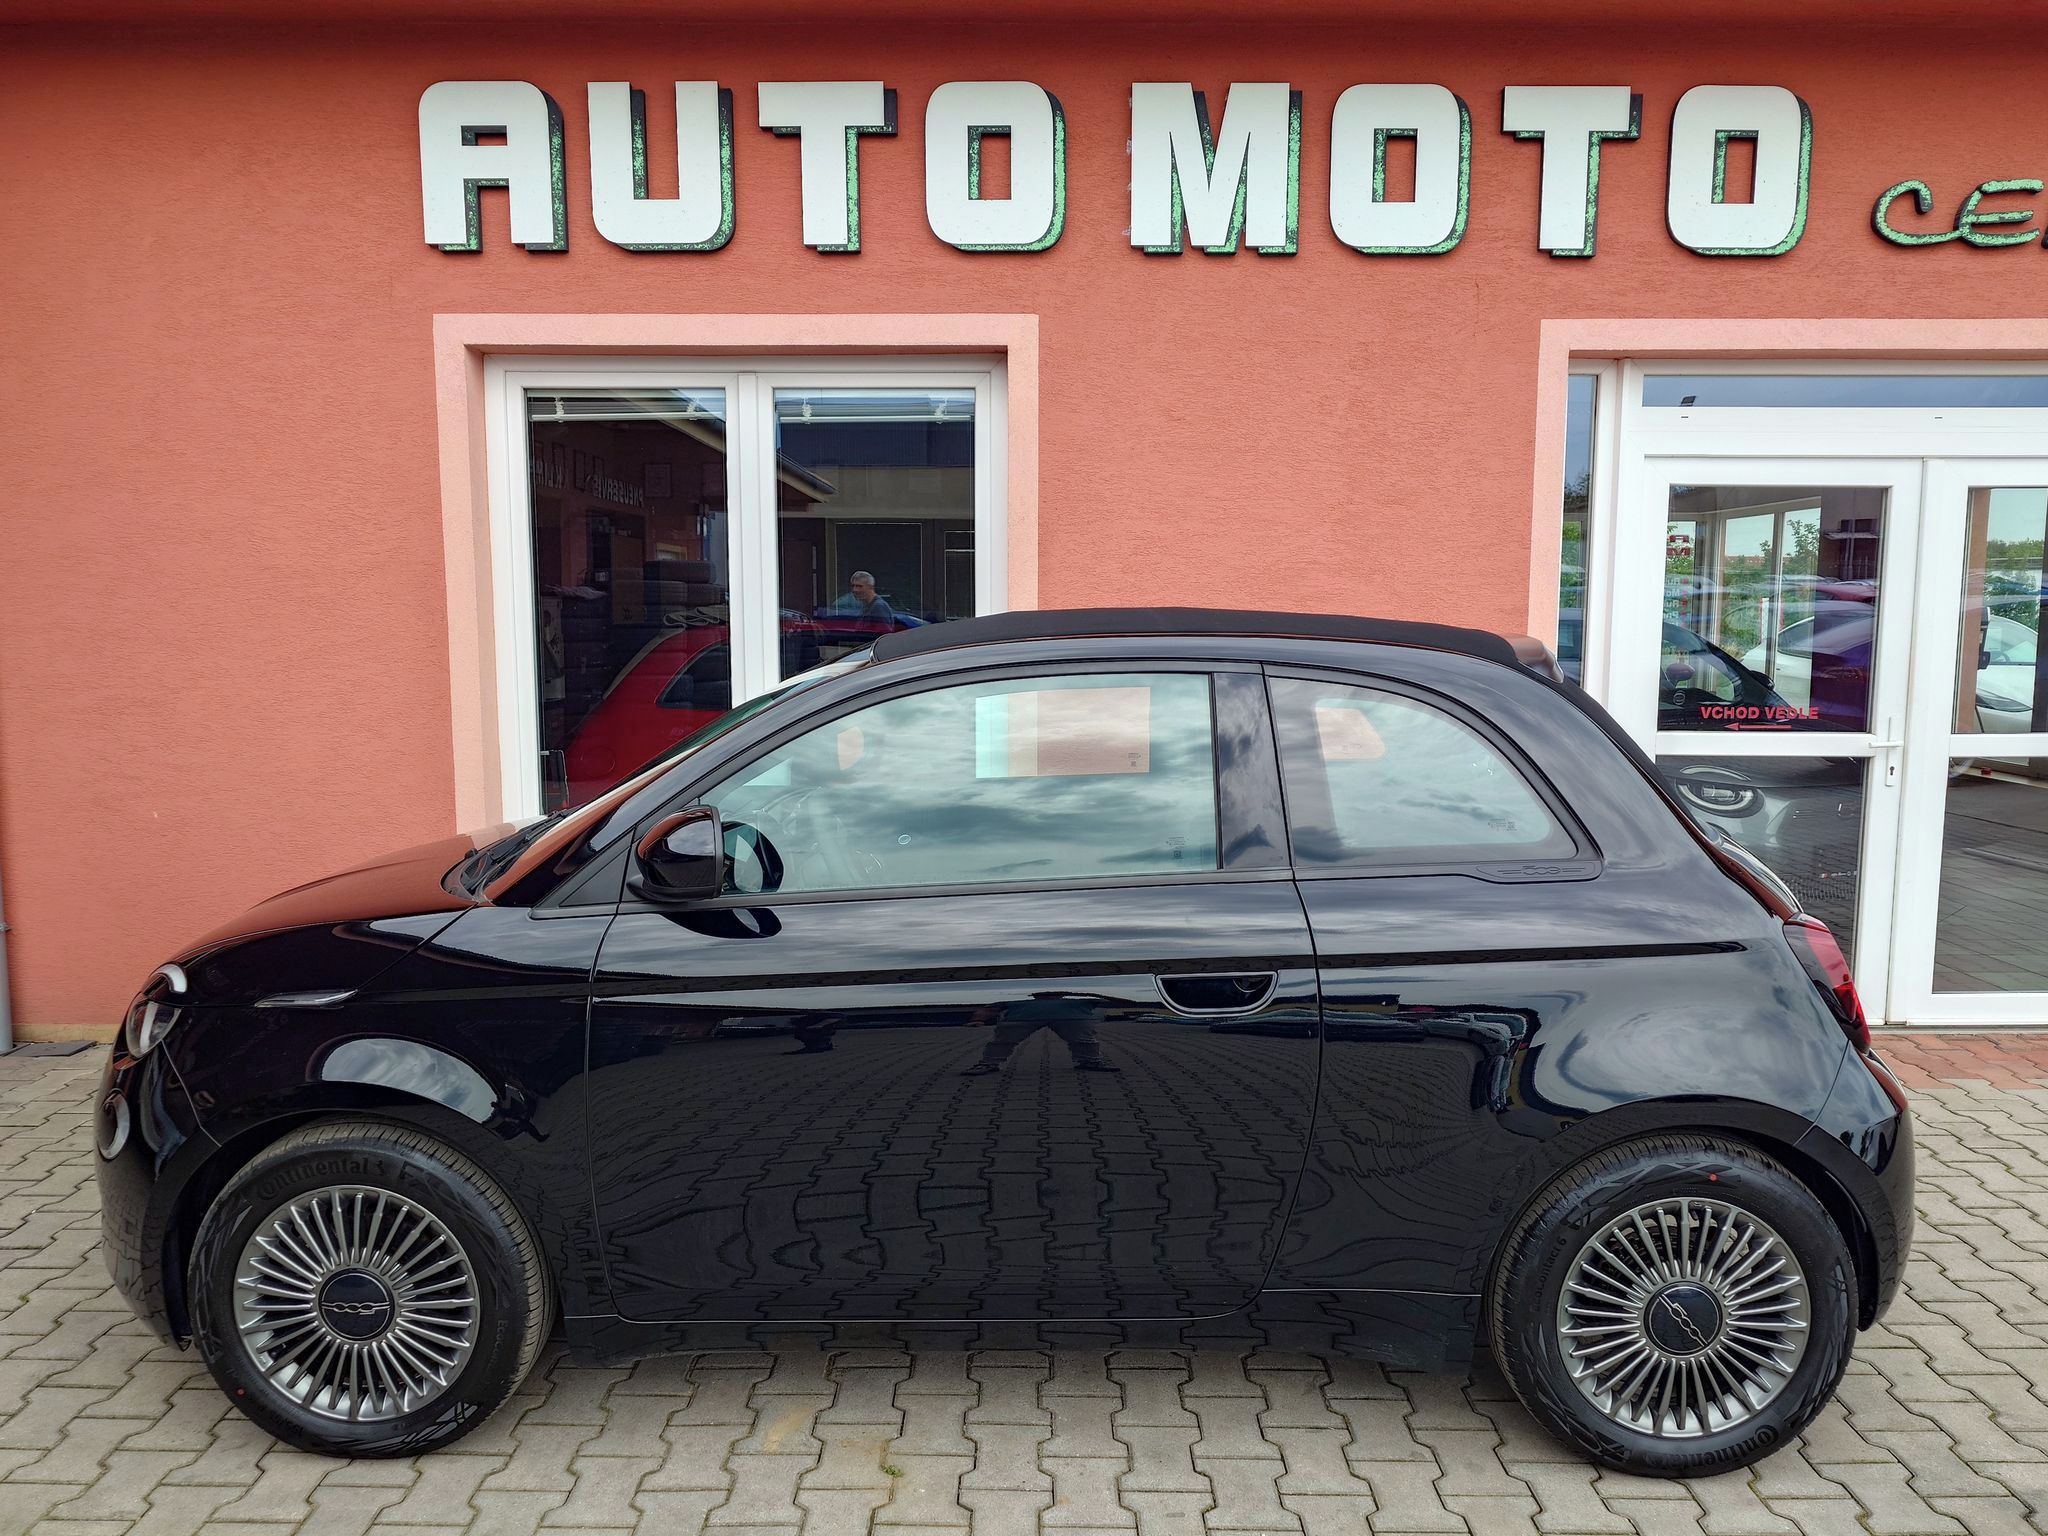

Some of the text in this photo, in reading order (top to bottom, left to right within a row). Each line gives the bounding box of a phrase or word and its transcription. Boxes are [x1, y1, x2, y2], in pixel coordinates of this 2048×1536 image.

[418, 80, 2048, 257] AUTO MOTO CE
[1700, 706, 1820, 720] VCHOD VEDLE
